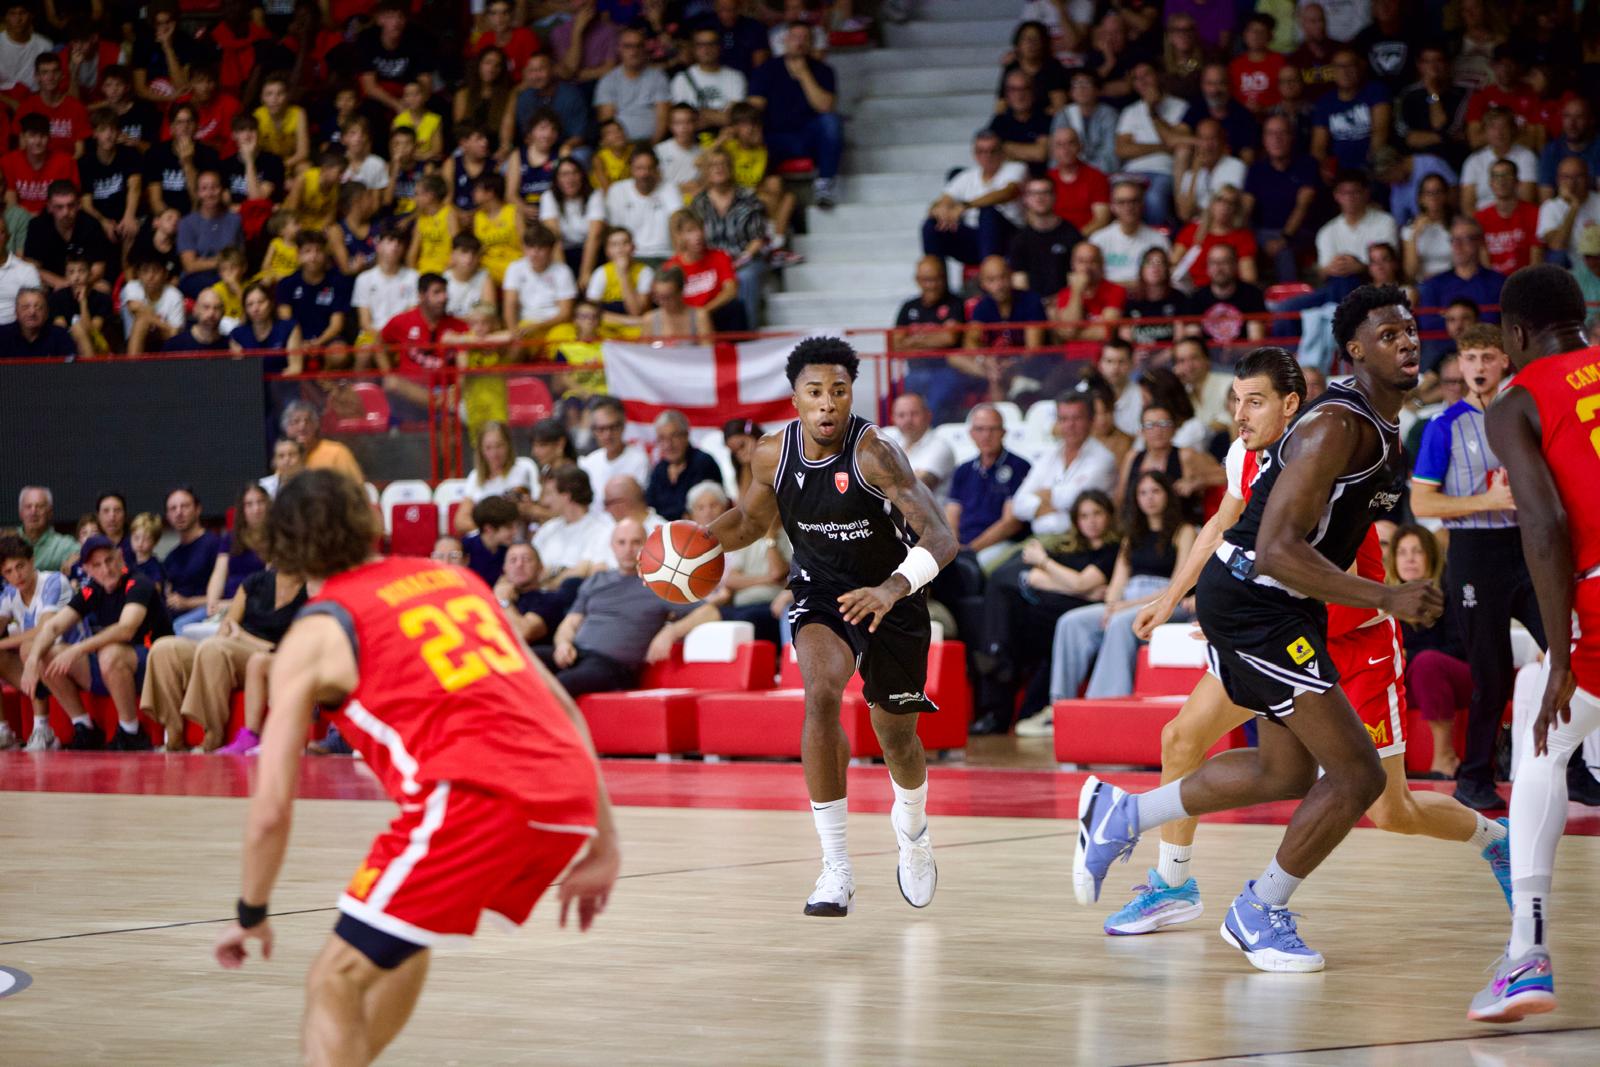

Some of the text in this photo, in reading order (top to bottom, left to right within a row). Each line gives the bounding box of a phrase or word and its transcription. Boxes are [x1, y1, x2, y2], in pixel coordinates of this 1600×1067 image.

[797, 519, 870, 534] openjobmetis
[828, 532, 838, 540] by
[398, 594, 527, 693] 23
